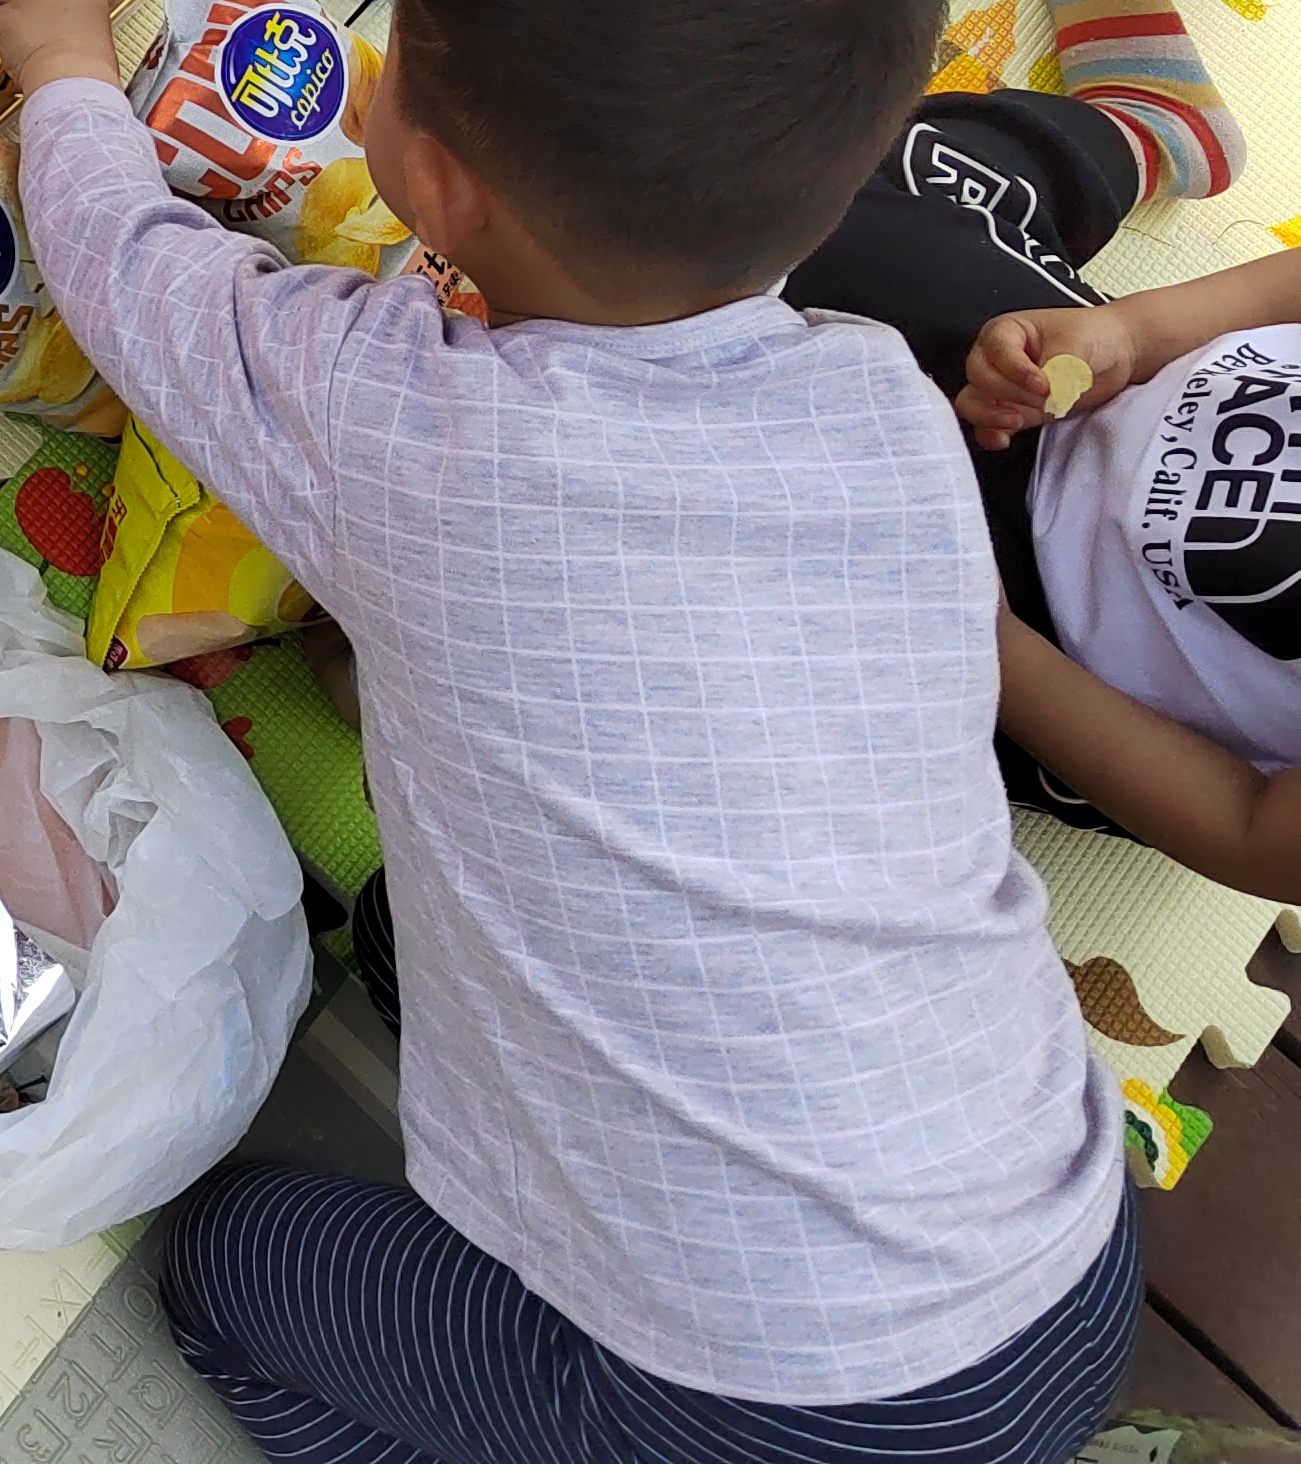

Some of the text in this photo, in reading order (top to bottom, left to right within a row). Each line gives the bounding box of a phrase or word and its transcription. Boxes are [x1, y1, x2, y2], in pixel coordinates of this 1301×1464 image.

[231, 11, 317, 117] 可比克
[290, 49, 334, 130] copico
[1194, 374, 1283, 512] ACE
[1157, 446, 1198, 533] Calif.
[1141, 542, 1195, 612] USA
